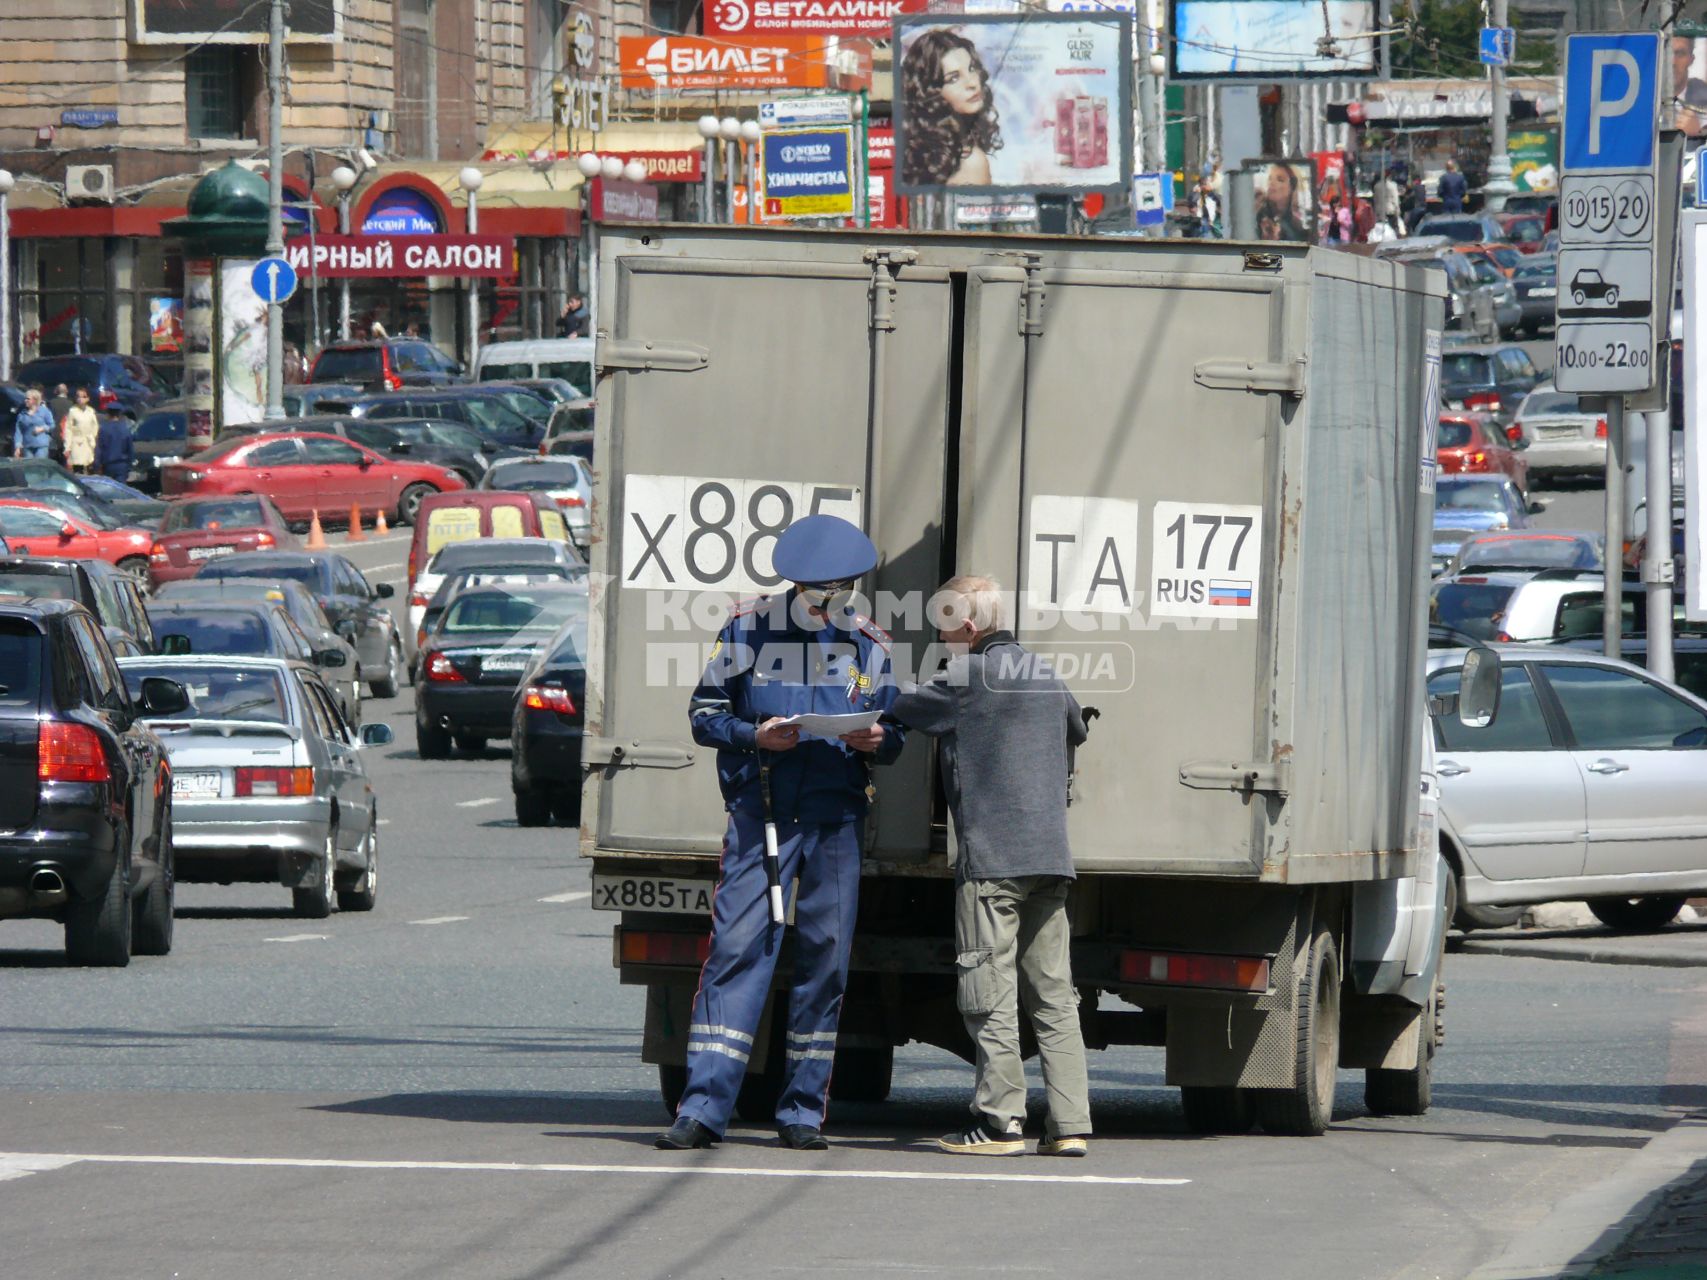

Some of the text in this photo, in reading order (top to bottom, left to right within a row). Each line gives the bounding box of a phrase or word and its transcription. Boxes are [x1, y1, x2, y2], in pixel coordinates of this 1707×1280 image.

[754, 1, 903, 17] БЕТАЛИНК
[1067, 40, 1094, 50] GLISS
[1069, 50, 1092, 61] KUR
[670, 47, 789, 73] БИЛЕТ
[1386, 102, 1493, 116] НАПИТКИ
[1589, 49, 1640, 155] P
[767, 170, 847, 188] ХИМЧИСТКА
[1568, 196, 1644, 219] 10 15 20
[405, 245, 502, 269] САЛОН
[1166, 514, 1253, 571] 177
[1157, 578, 1205, 604] RUS
